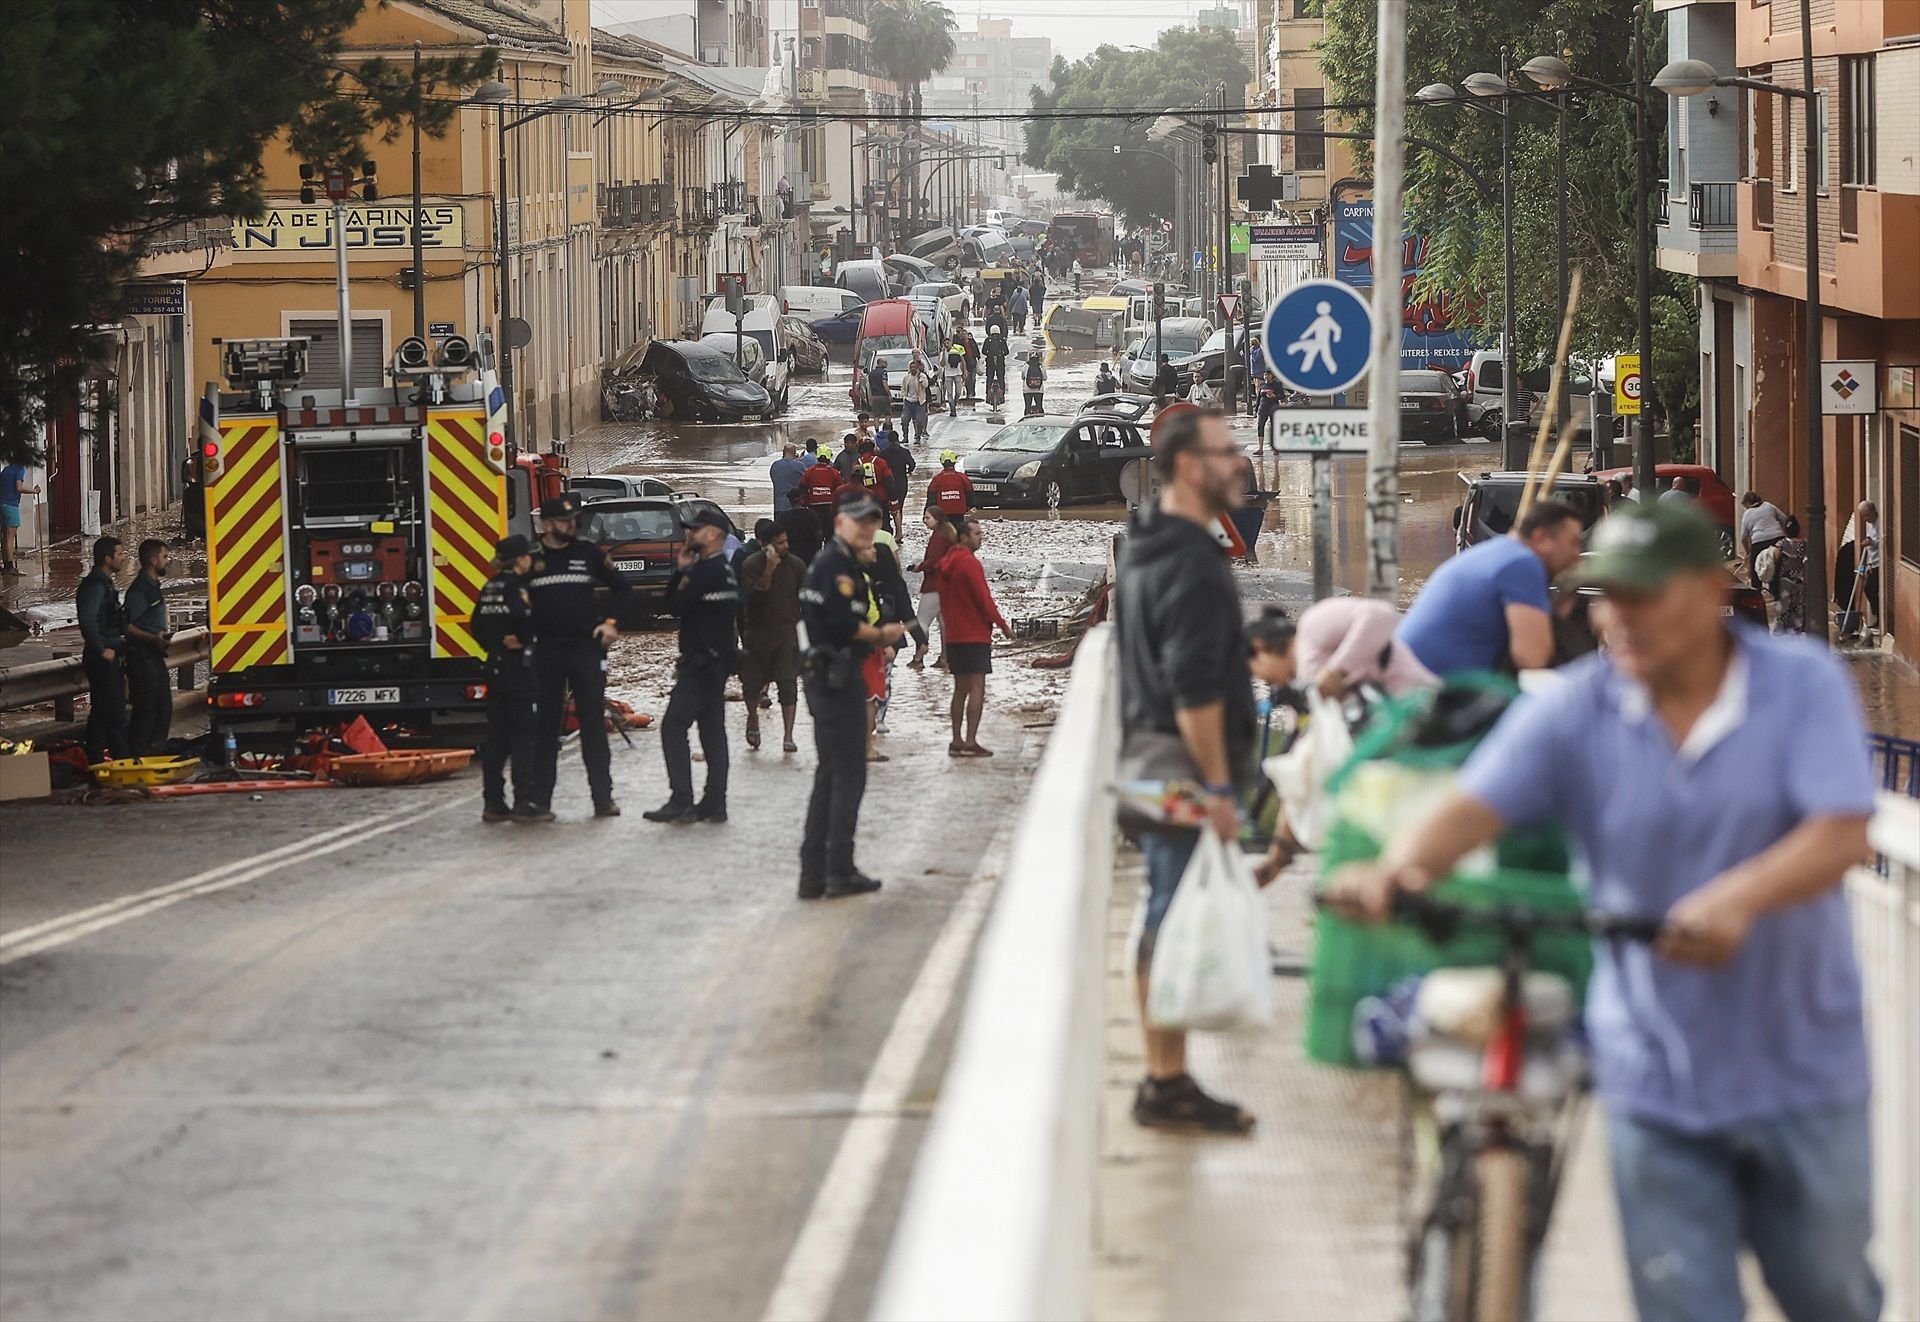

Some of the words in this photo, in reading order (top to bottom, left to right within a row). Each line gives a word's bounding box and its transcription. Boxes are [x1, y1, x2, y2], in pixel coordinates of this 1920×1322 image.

[292, 214, 318, 227] DE
[326, 209, 453, 226] HARINAS
[300, 226, 443, 248] JOSE
[1433, 348, 1460, 357] REIXES
[1627, 382, 1641, 392] 30
[337, 690, 367, 702] 7226
